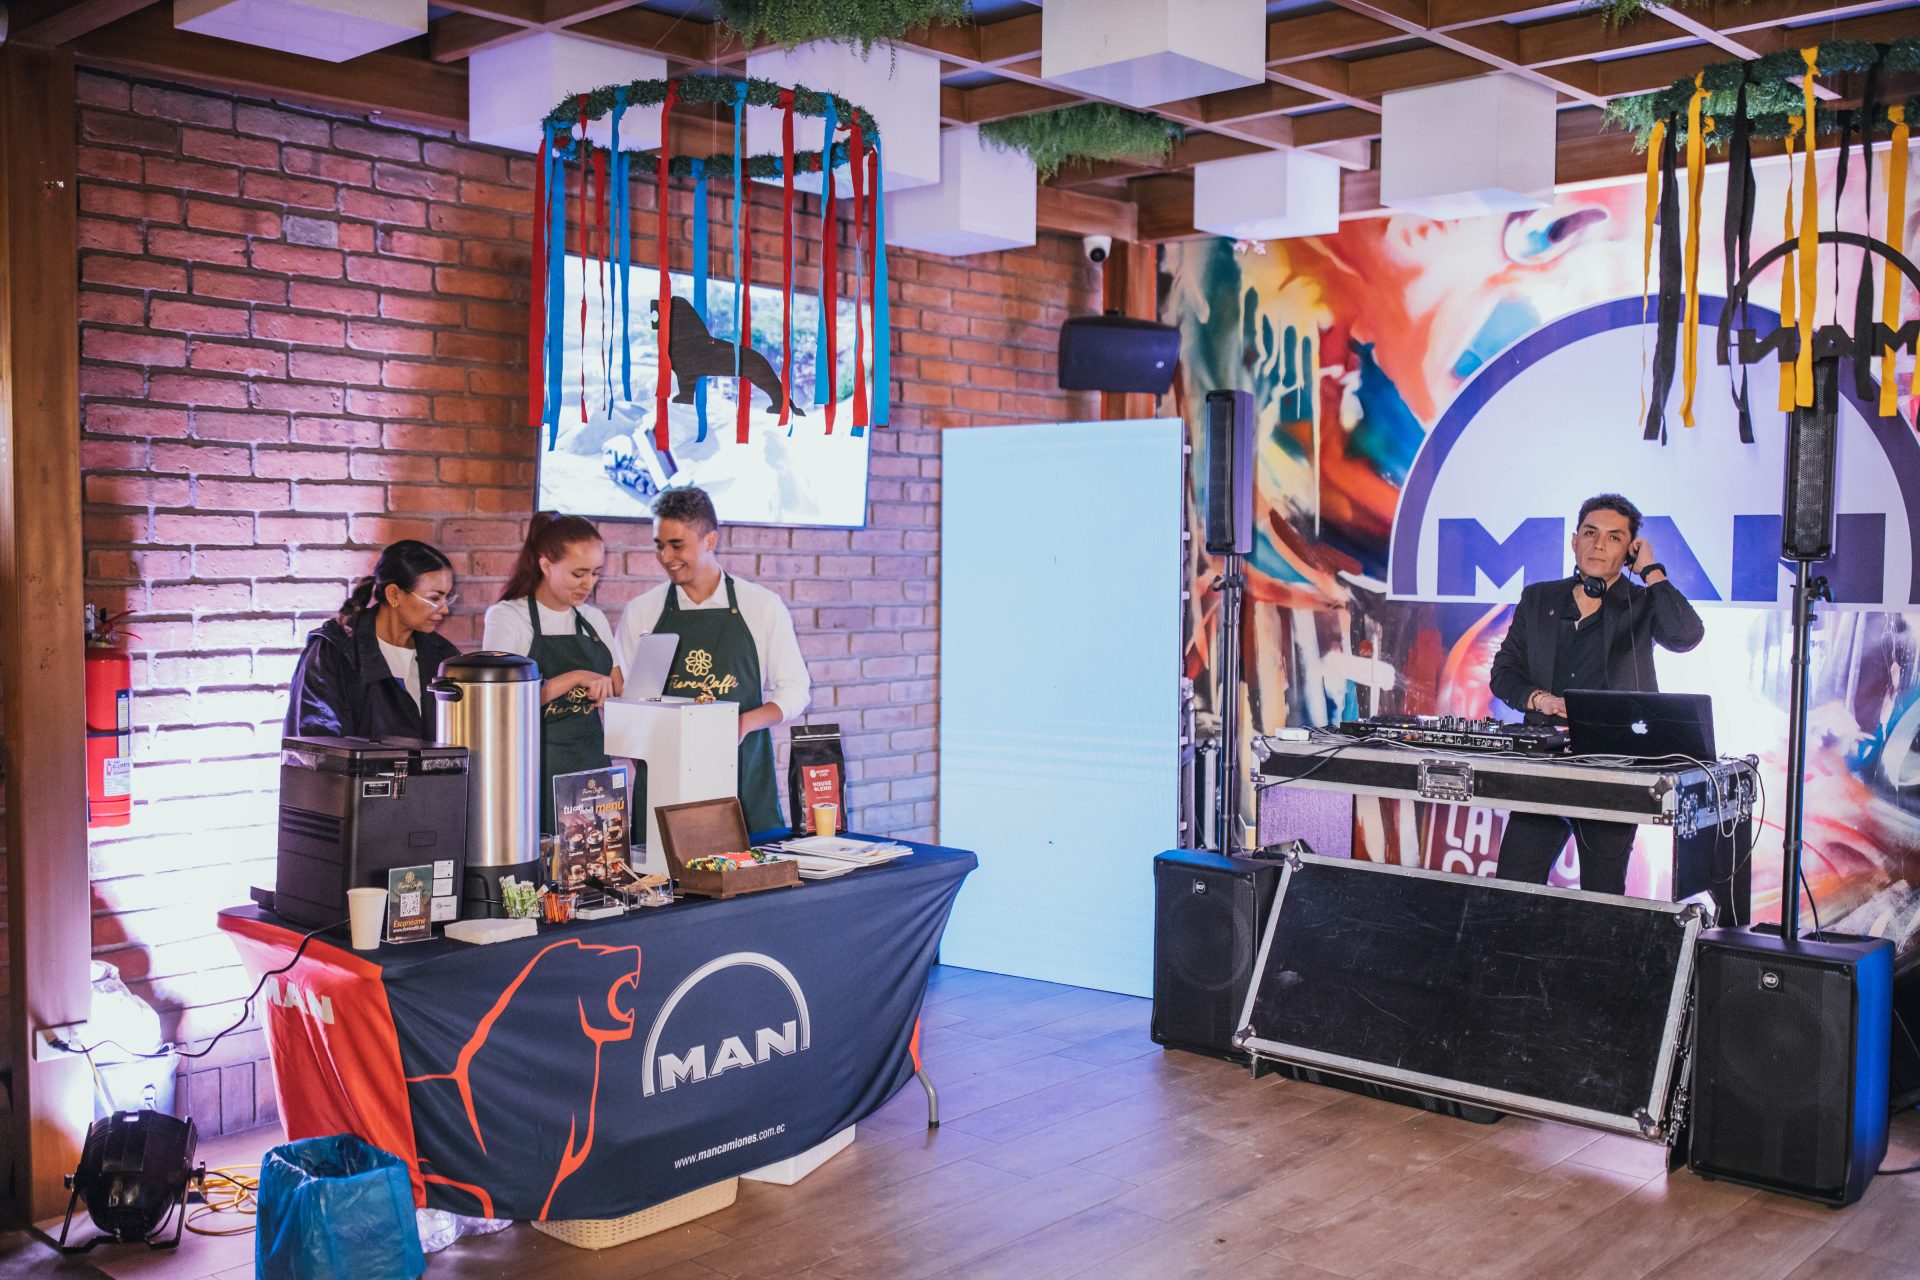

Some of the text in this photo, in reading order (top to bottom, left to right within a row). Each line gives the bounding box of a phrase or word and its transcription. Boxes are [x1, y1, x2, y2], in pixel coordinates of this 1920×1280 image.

[563, 804, 573, 815] tu
[595, 797, 625, 814] menú
[658, 1020, 797, 1093] MAN
[674, 1123, 786, 1169] www.mancamiones.com.ec
